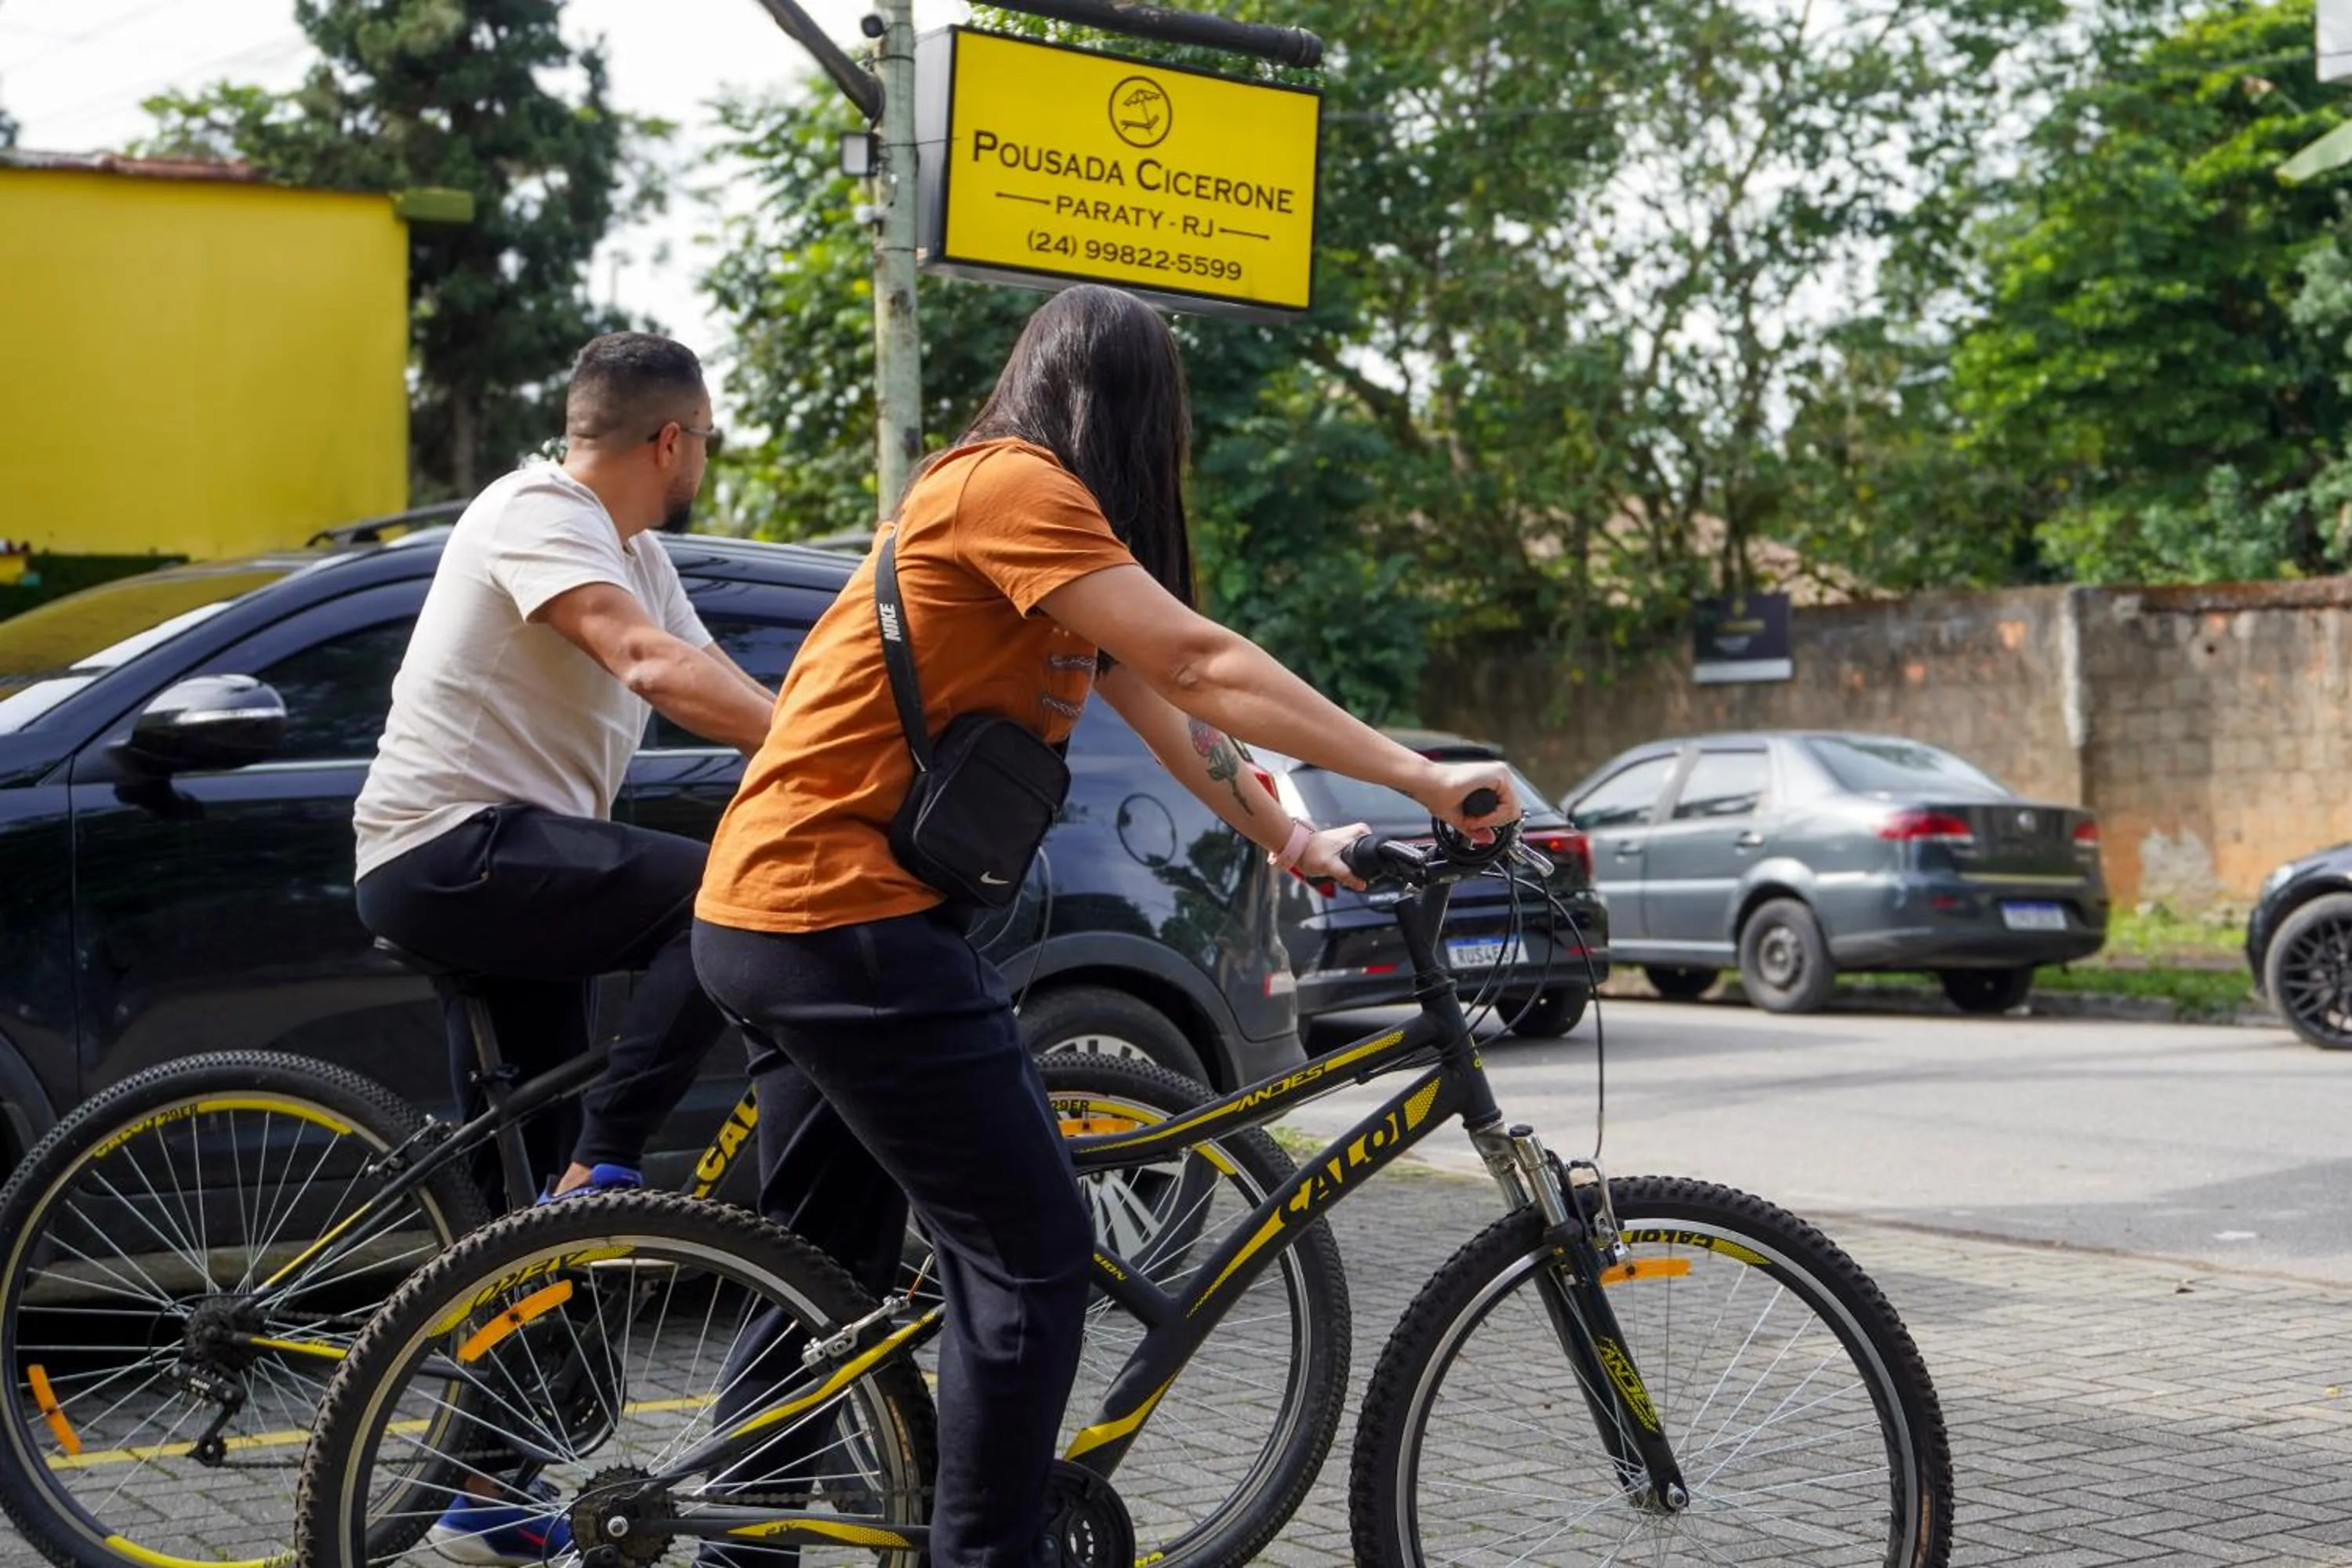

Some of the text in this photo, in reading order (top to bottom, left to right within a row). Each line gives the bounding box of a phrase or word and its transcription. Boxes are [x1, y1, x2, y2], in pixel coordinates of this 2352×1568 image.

[971, 129, 1294, 215] POUSADA CICERONE
[1027, 228, 1243, 281] (24) 99822-5599
[879, 602, 902, 642] NIKE
[1238, 1063, 1324, 1112] ANDES
[695, 1084, 760, 1181] CAL
[1281, 1105, 1407, 1221] CALOI
[1630, 1229, 1715, 1248] CALOI
